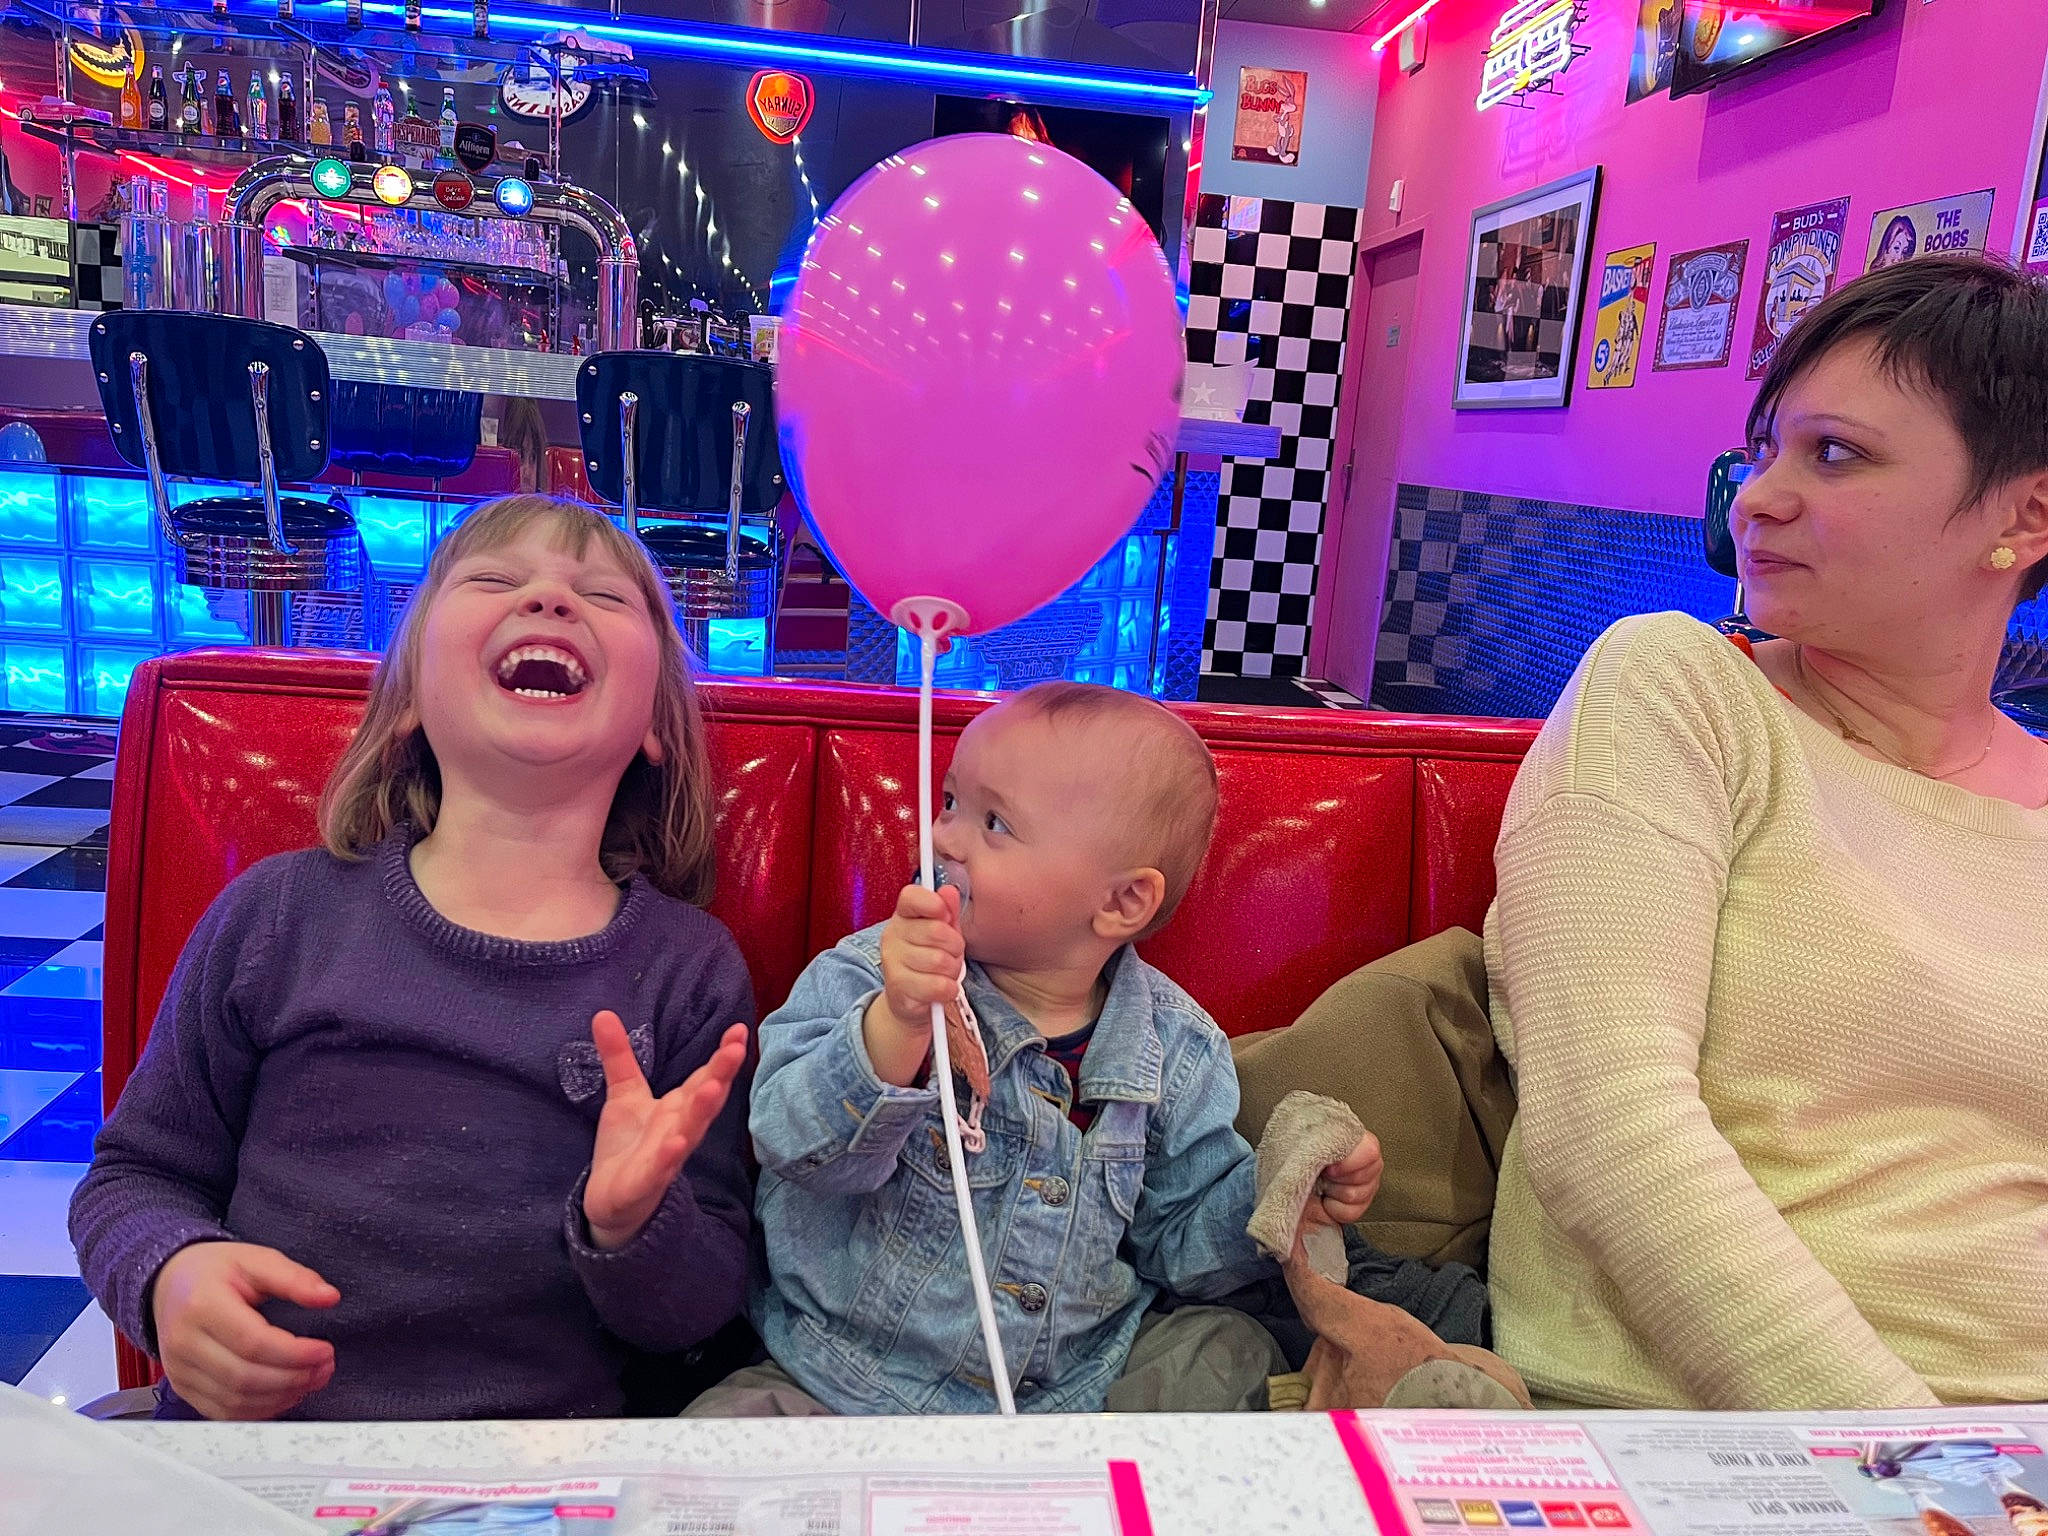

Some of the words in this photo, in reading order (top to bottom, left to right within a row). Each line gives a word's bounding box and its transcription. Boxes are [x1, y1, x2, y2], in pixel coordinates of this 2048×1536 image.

[1246, 75, 1278, 95] BUGS
[1241, 93, 1284, 114] BUNNY
[1936, 208, 1962, 230] THE
[1924, 228, 1970, 253] BOOBS
[1706, 1451, 1753, 1467] KINGS
[1754, 1452, 1776, 1466] OF
[1772, 1452, 1811, 1467] KING
[1746, 1501, 1789, 1515] SPLIT
[1788, 1499, 1850, 1515] BANANA
